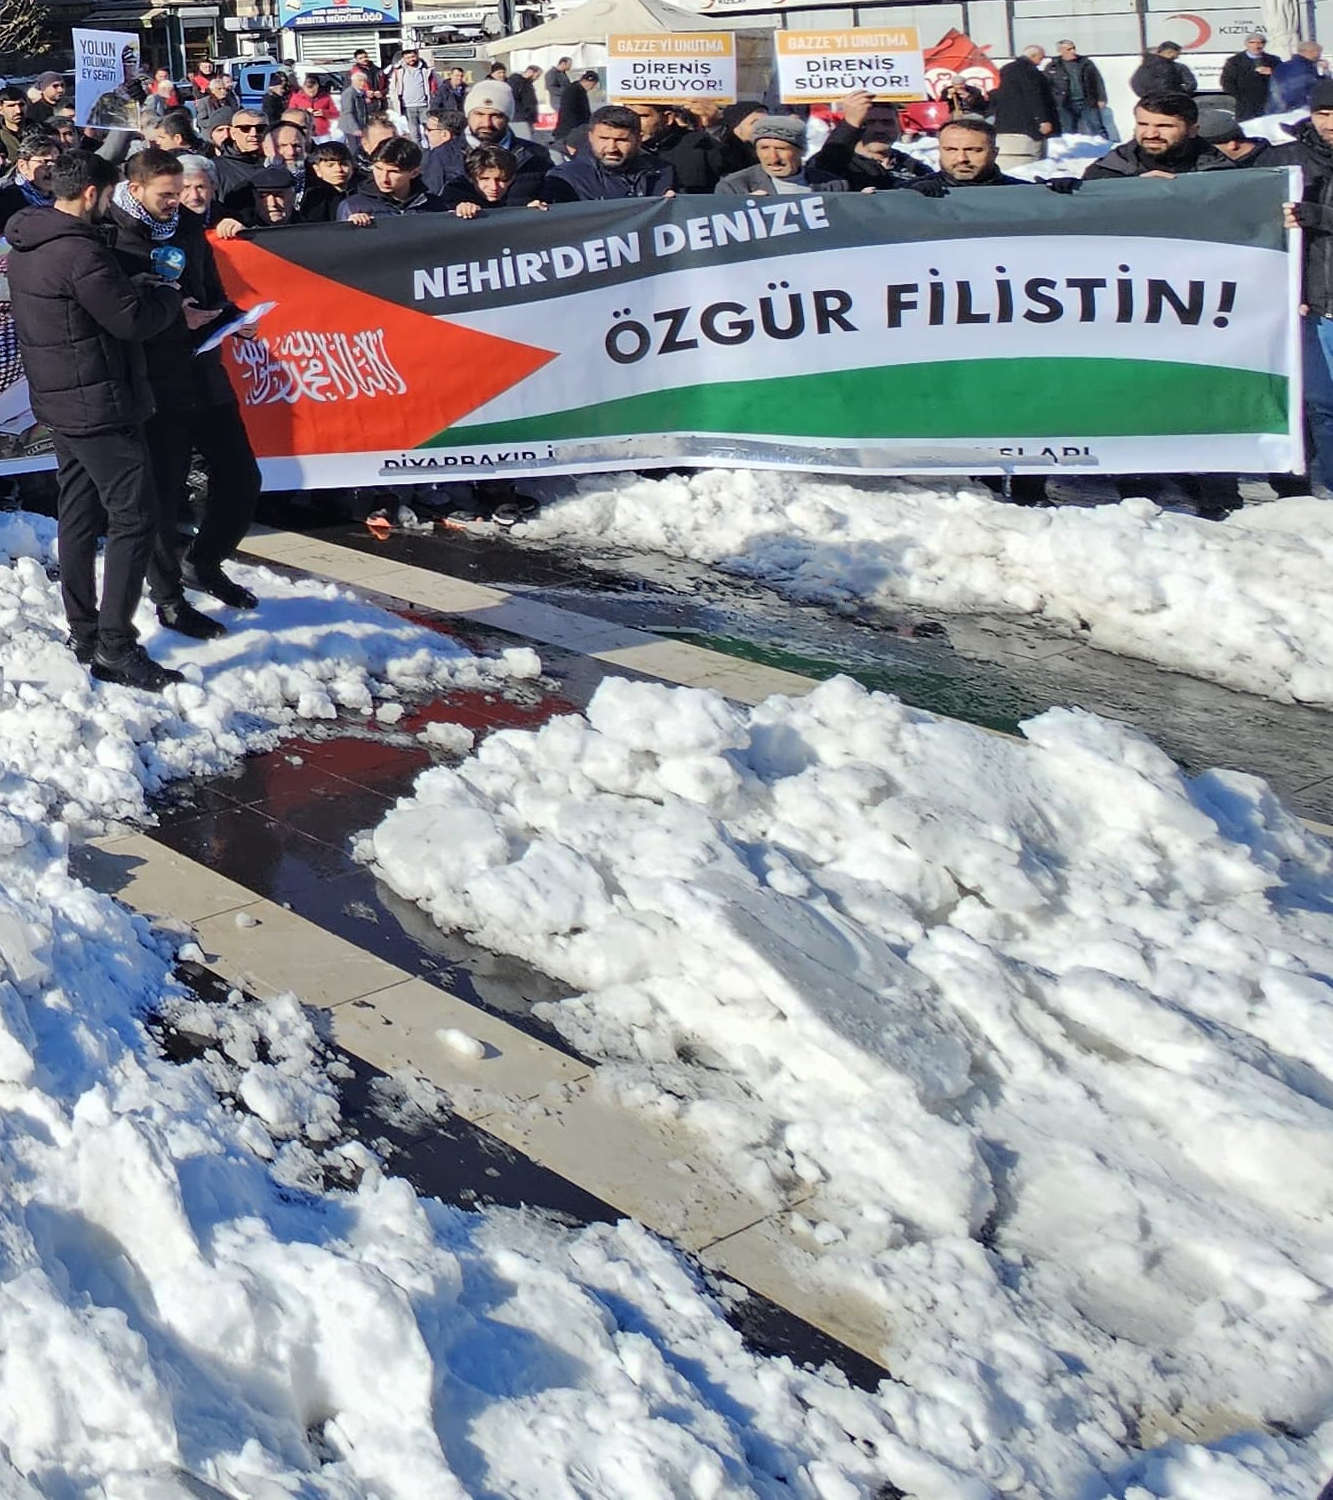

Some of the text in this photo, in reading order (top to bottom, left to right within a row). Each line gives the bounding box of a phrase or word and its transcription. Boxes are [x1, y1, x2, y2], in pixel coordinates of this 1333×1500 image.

[80, 39, 116, 57] YOLUN
[633, 60, 711, 77] DİRENİŞ
[806, 55, 895, 74] DİRENİŞ
[82, 68, 92, 79] EY
[795, 74, 910, 90] SÜRÜYOR!
[620, 76, 724, 91] SÜRÜYOR!
[414, 196, 831, 301] NEHİR'DEN DENİZ'E
[604, 264, 1238, 365] ÖZGÜR FİLİSTİN!
